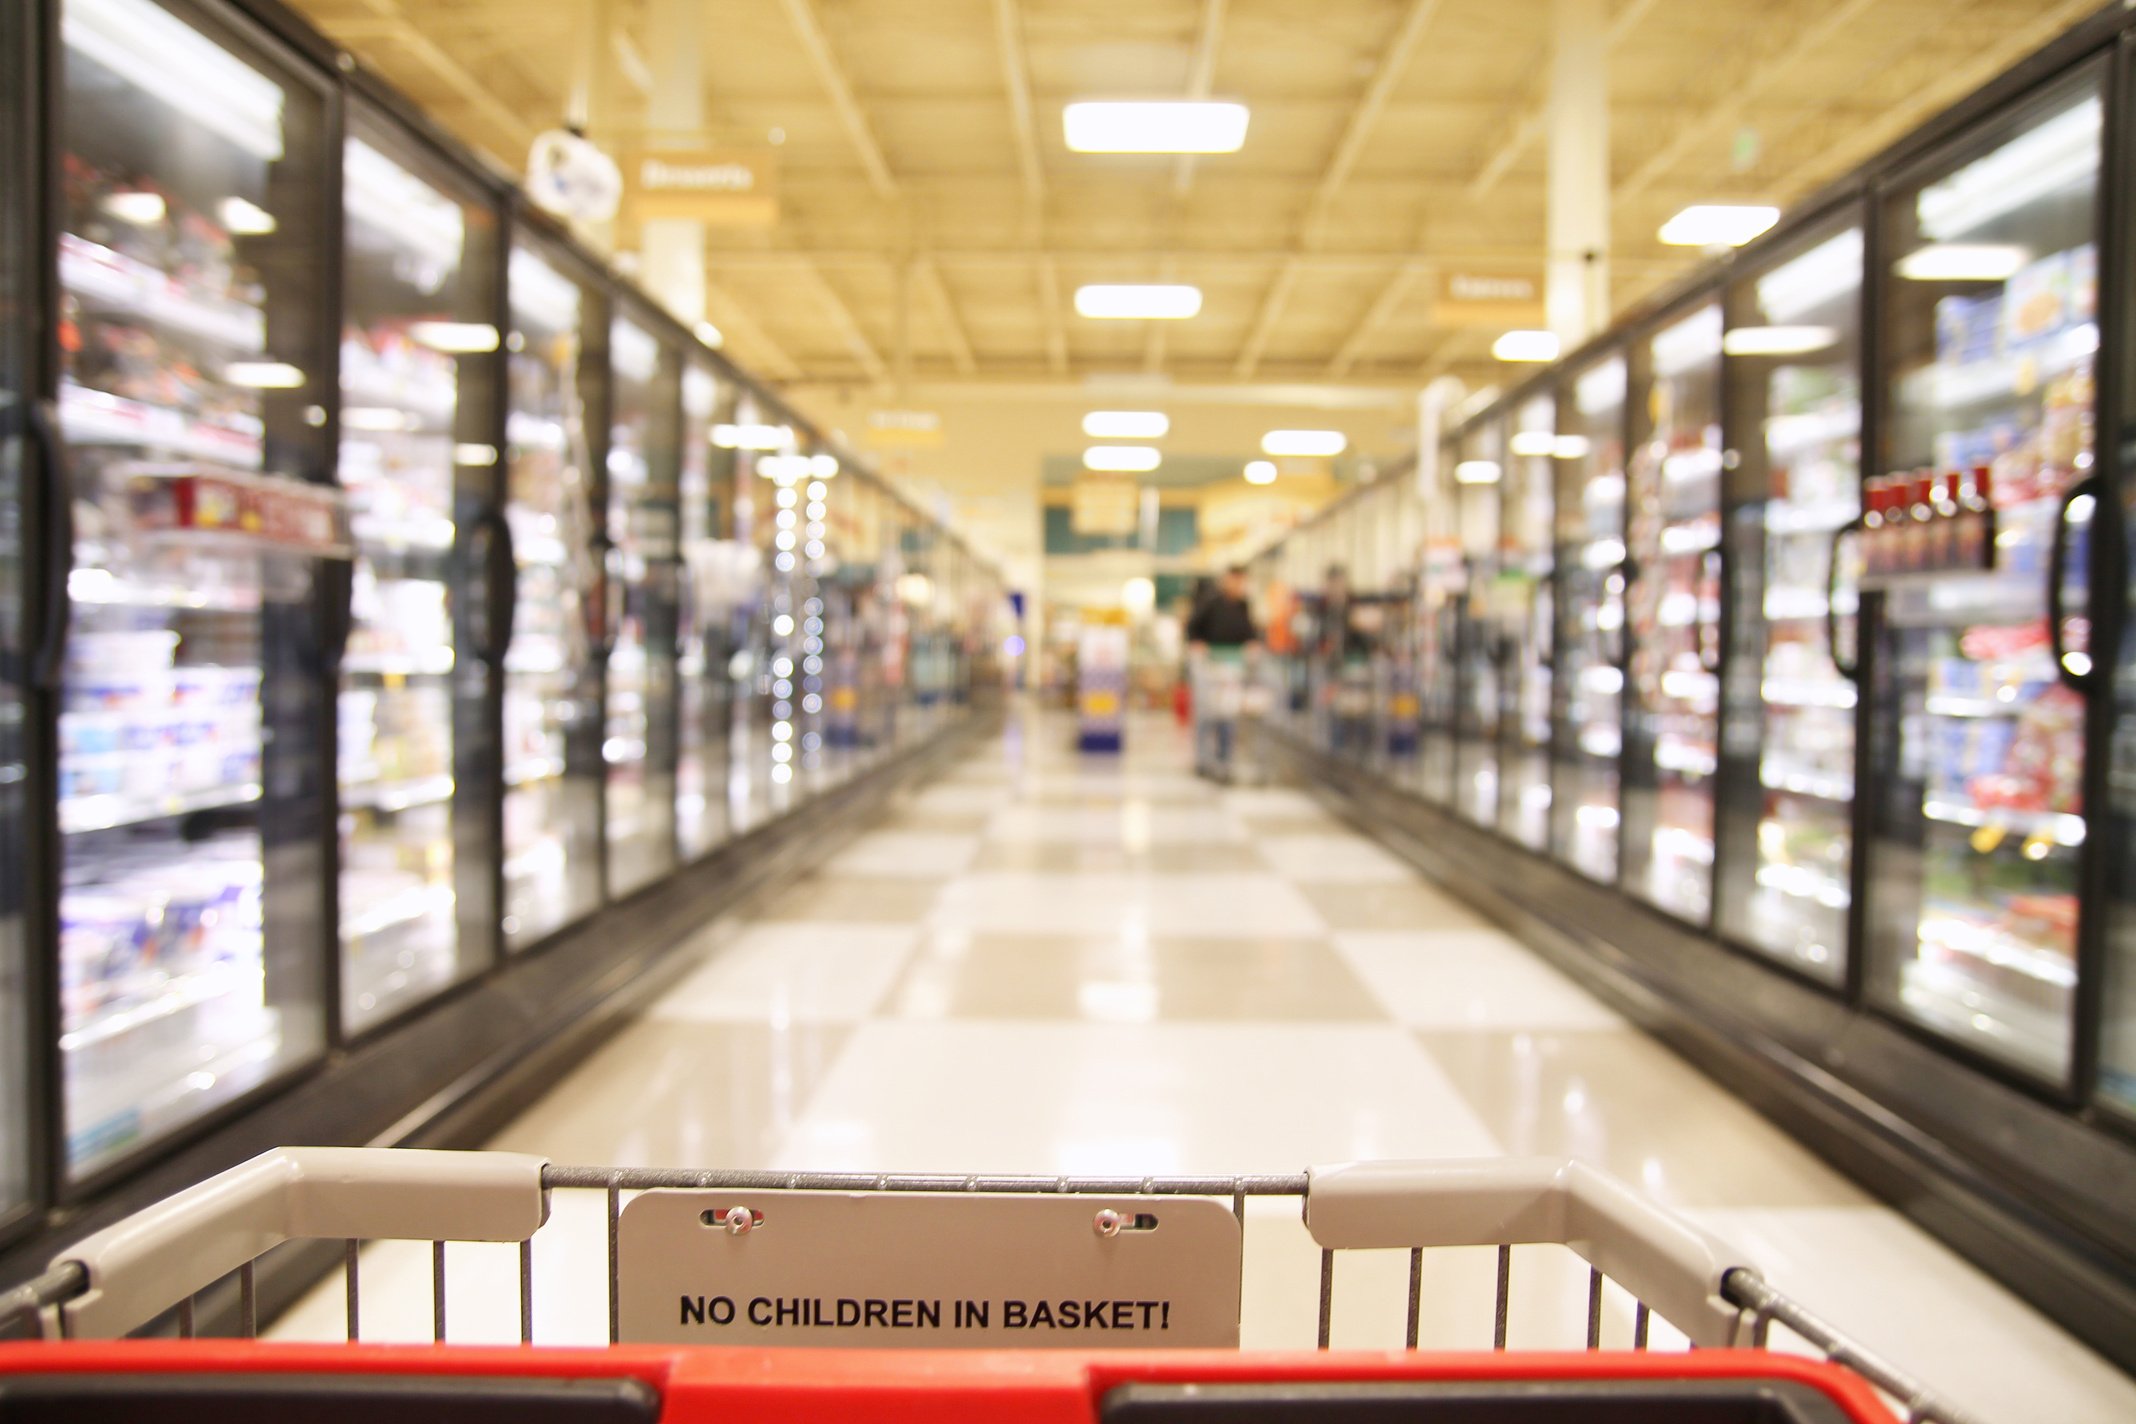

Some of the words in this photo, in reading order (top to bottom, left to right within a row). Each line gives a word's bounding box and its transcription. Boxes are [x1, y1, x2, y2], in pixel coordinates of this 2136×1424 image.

[680, 1295, 736, 1326] NO
[748, 1297, 941, 1329] CHILDREN
[954, 1299, 990, 1329] IN
[1003, 1300, 1171, 1331] BASKET!
